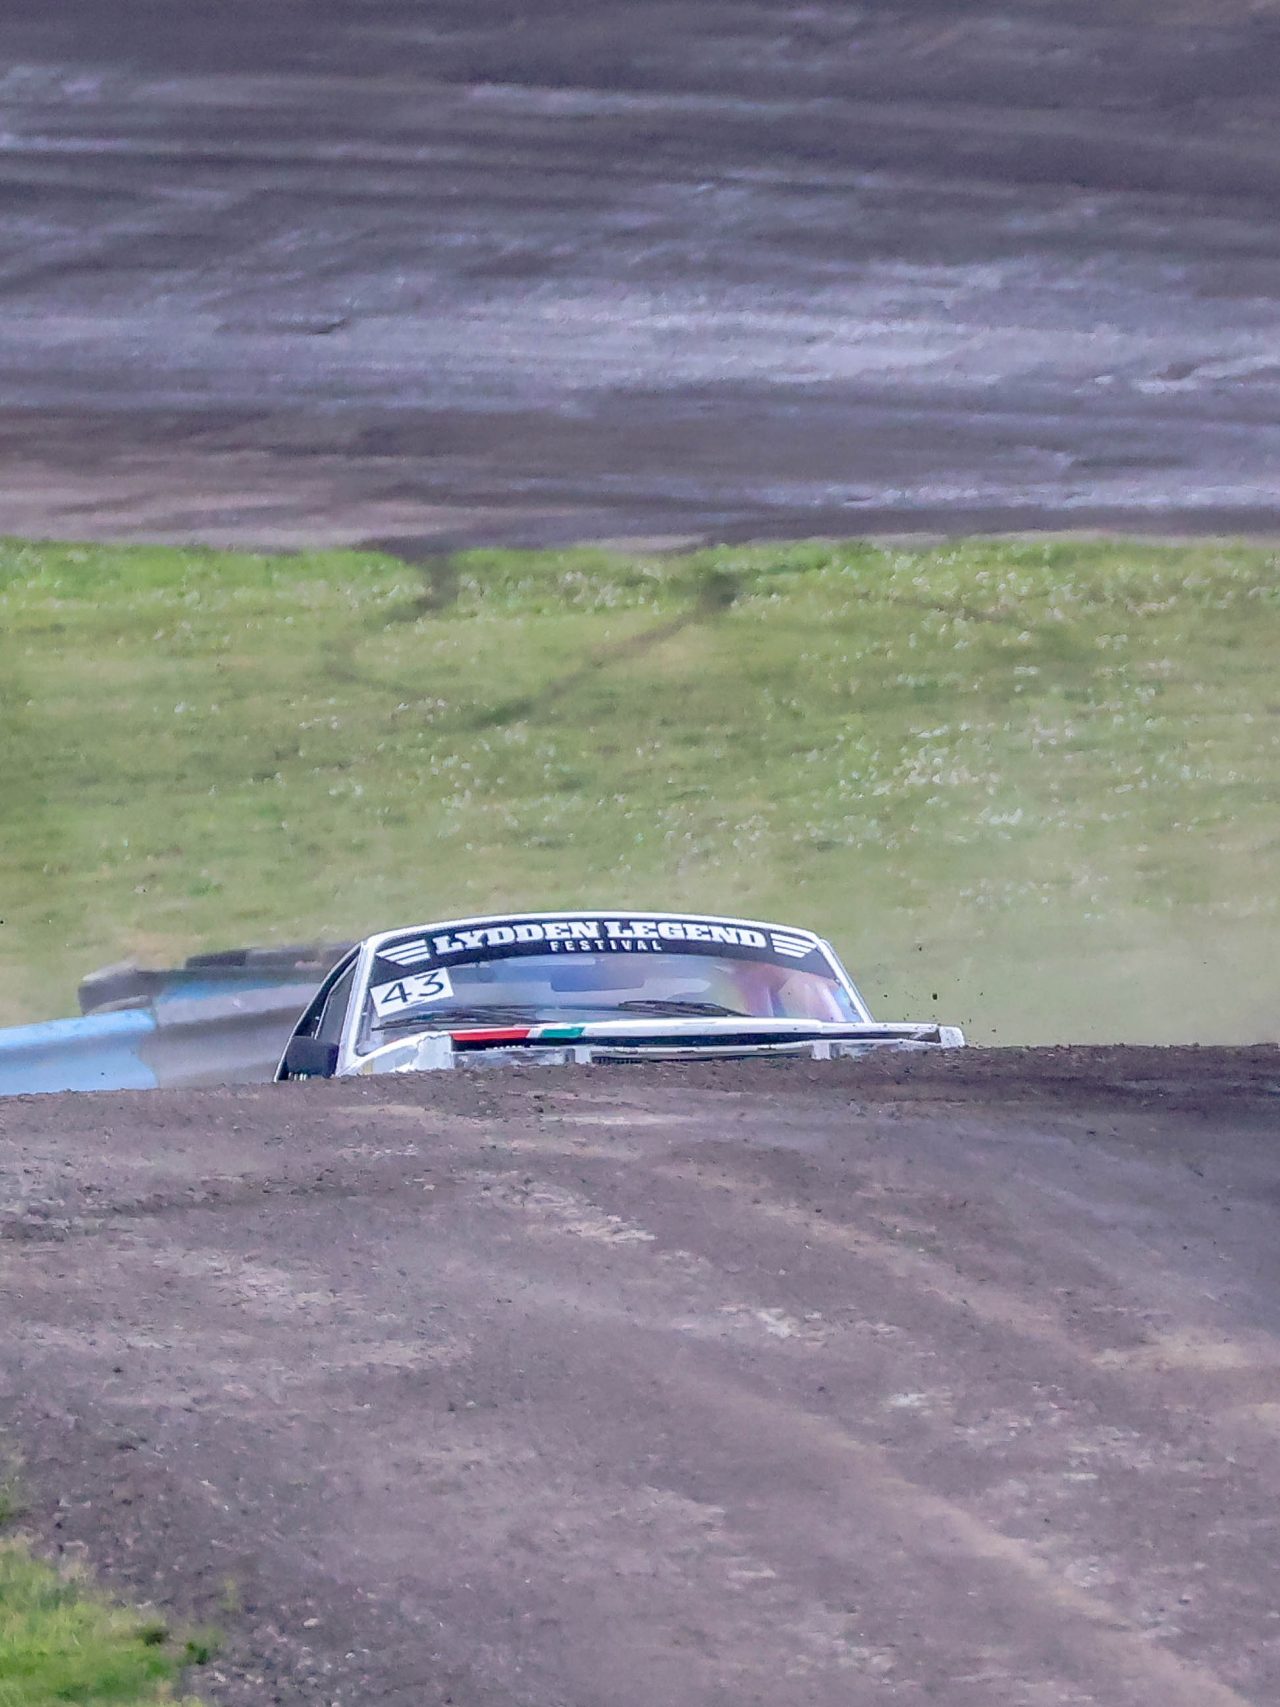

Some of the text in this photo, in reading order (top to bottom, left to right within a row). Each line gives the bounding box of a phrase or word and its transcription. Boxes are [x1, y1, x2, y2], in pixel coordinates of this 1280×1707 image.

[432, 921, 767, 955] LYDDEN LEGEND
[550, 939, 663, 951] FESTIVAL
[381, 971, 445, 1004] 43
